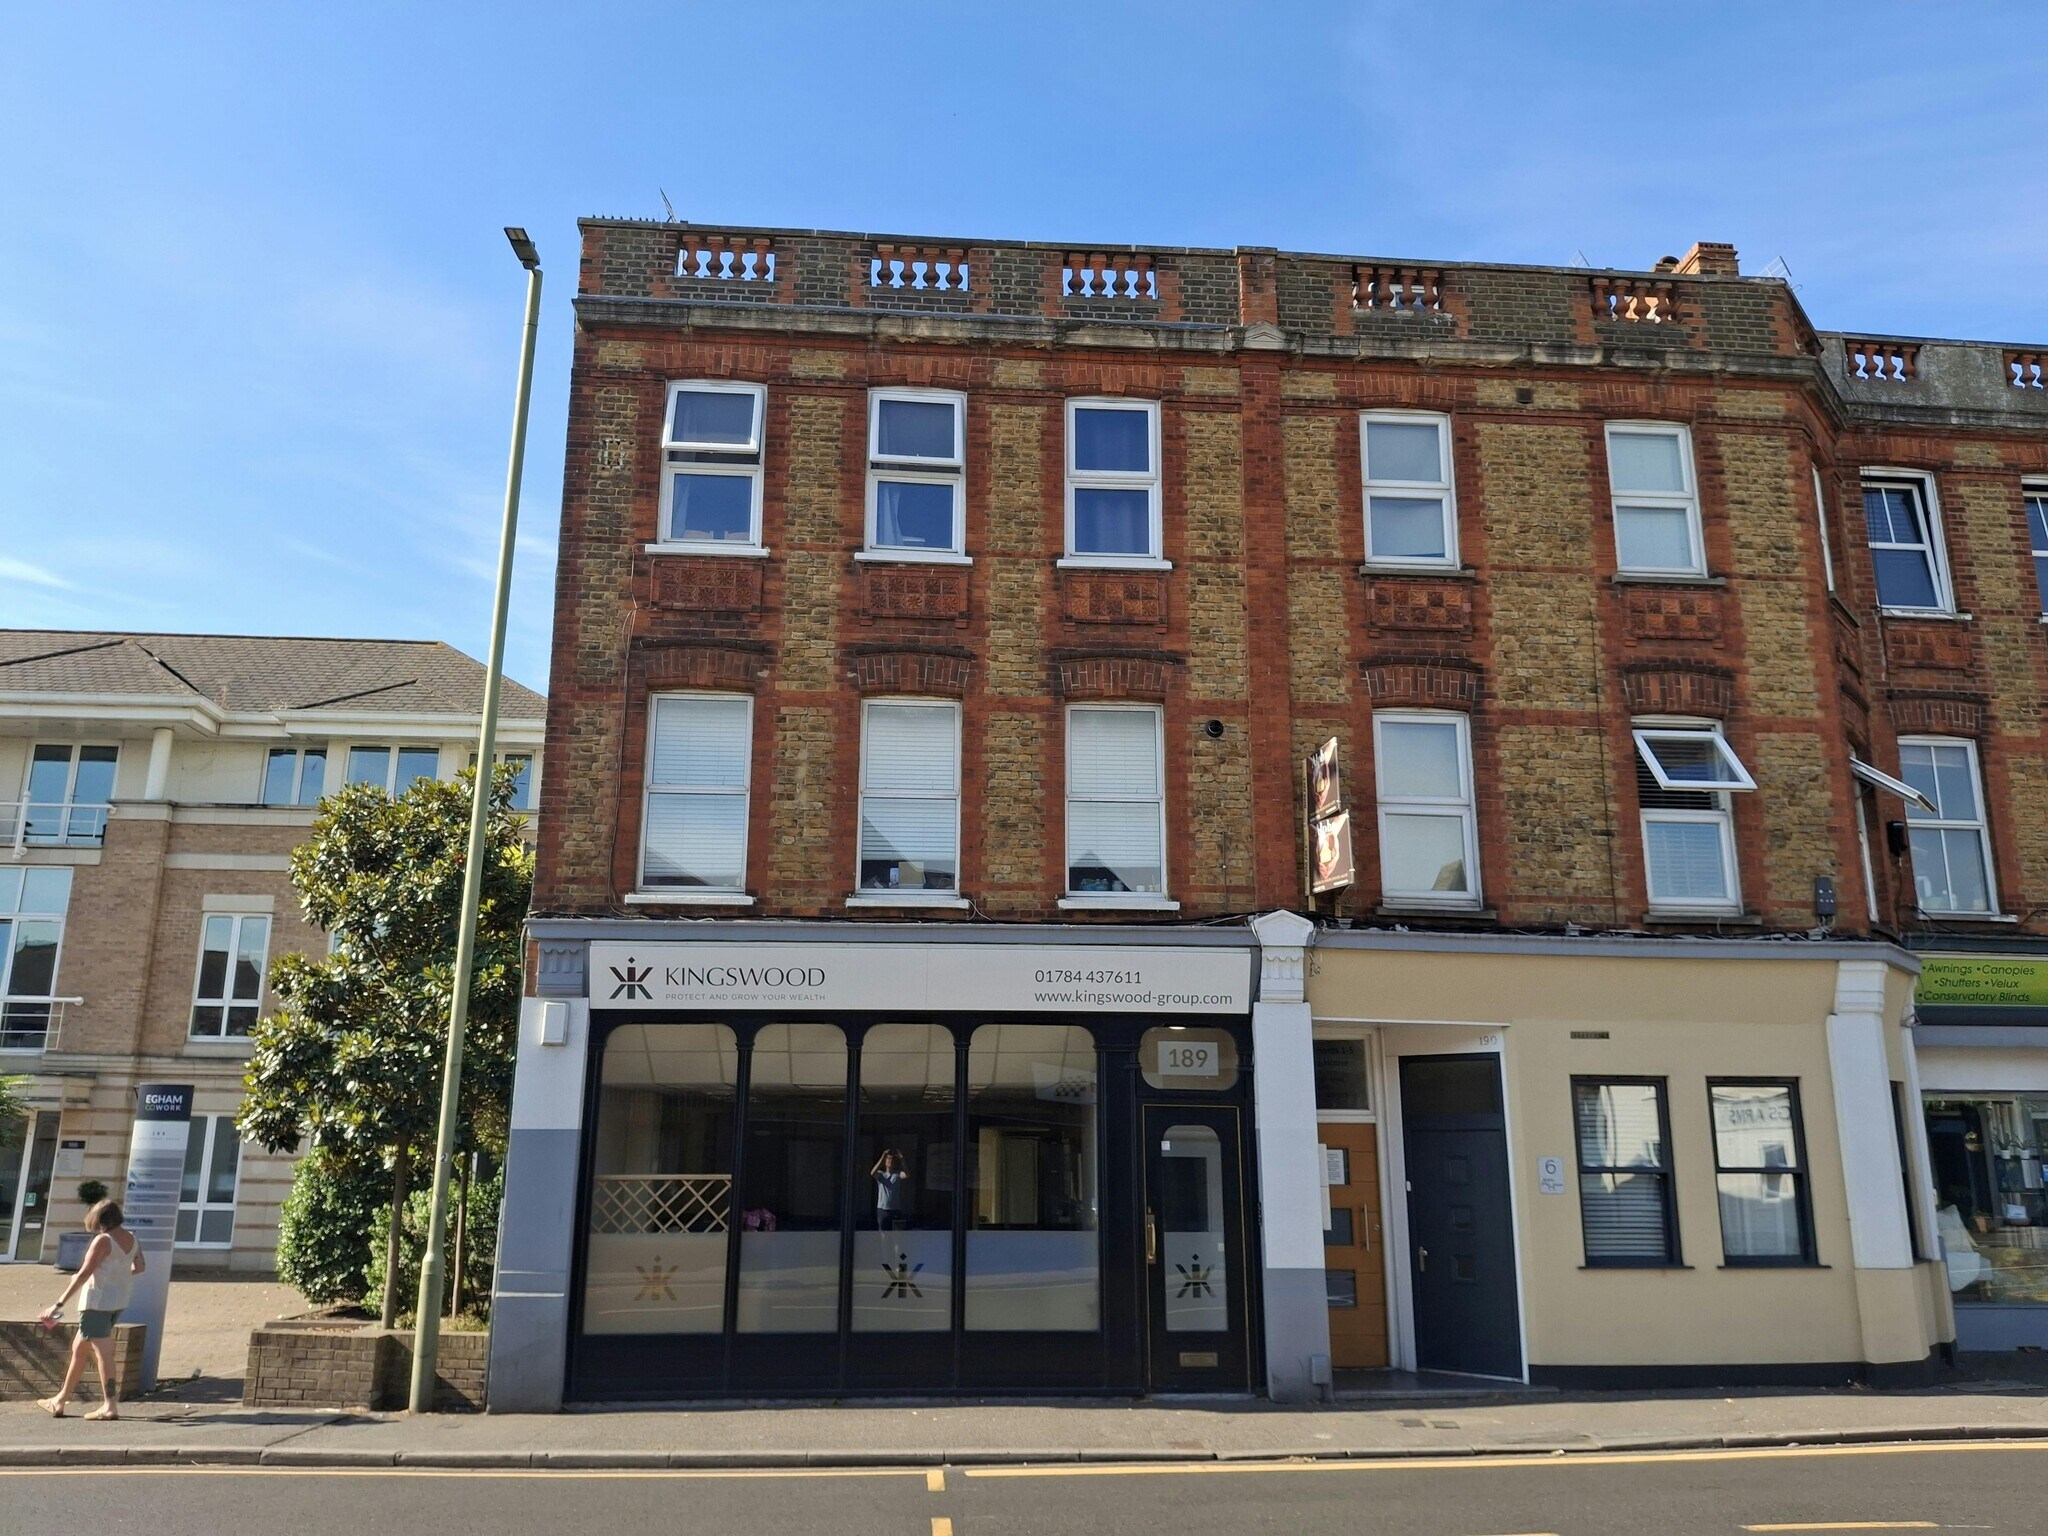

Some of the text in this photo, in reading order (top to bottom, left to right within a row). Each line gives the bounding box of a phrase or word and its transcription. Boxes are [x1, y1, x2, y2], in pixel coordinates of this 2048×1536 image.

[666, 967, 826, 987] KINGSWOOD
[1034, 970, 1142, 984] 01784 437611
[1927, 963, 2035, 977] Awnings Canopies
[1938, 977, 2020, 989] Shutters Velux
[665, 993, 826, 1001] PROTECT AND GROW YOUR WEALTH
[1034, 989, 1233, 1007] www.kingswood-group.com
[1924, 991, 2031, 1003] Conservatory Blinds
[1168, 1048, 1209, 1068] 189
[145, 1094, 183, 1105] EGHAM
[1544, 1159, 1557, 1175] 6
